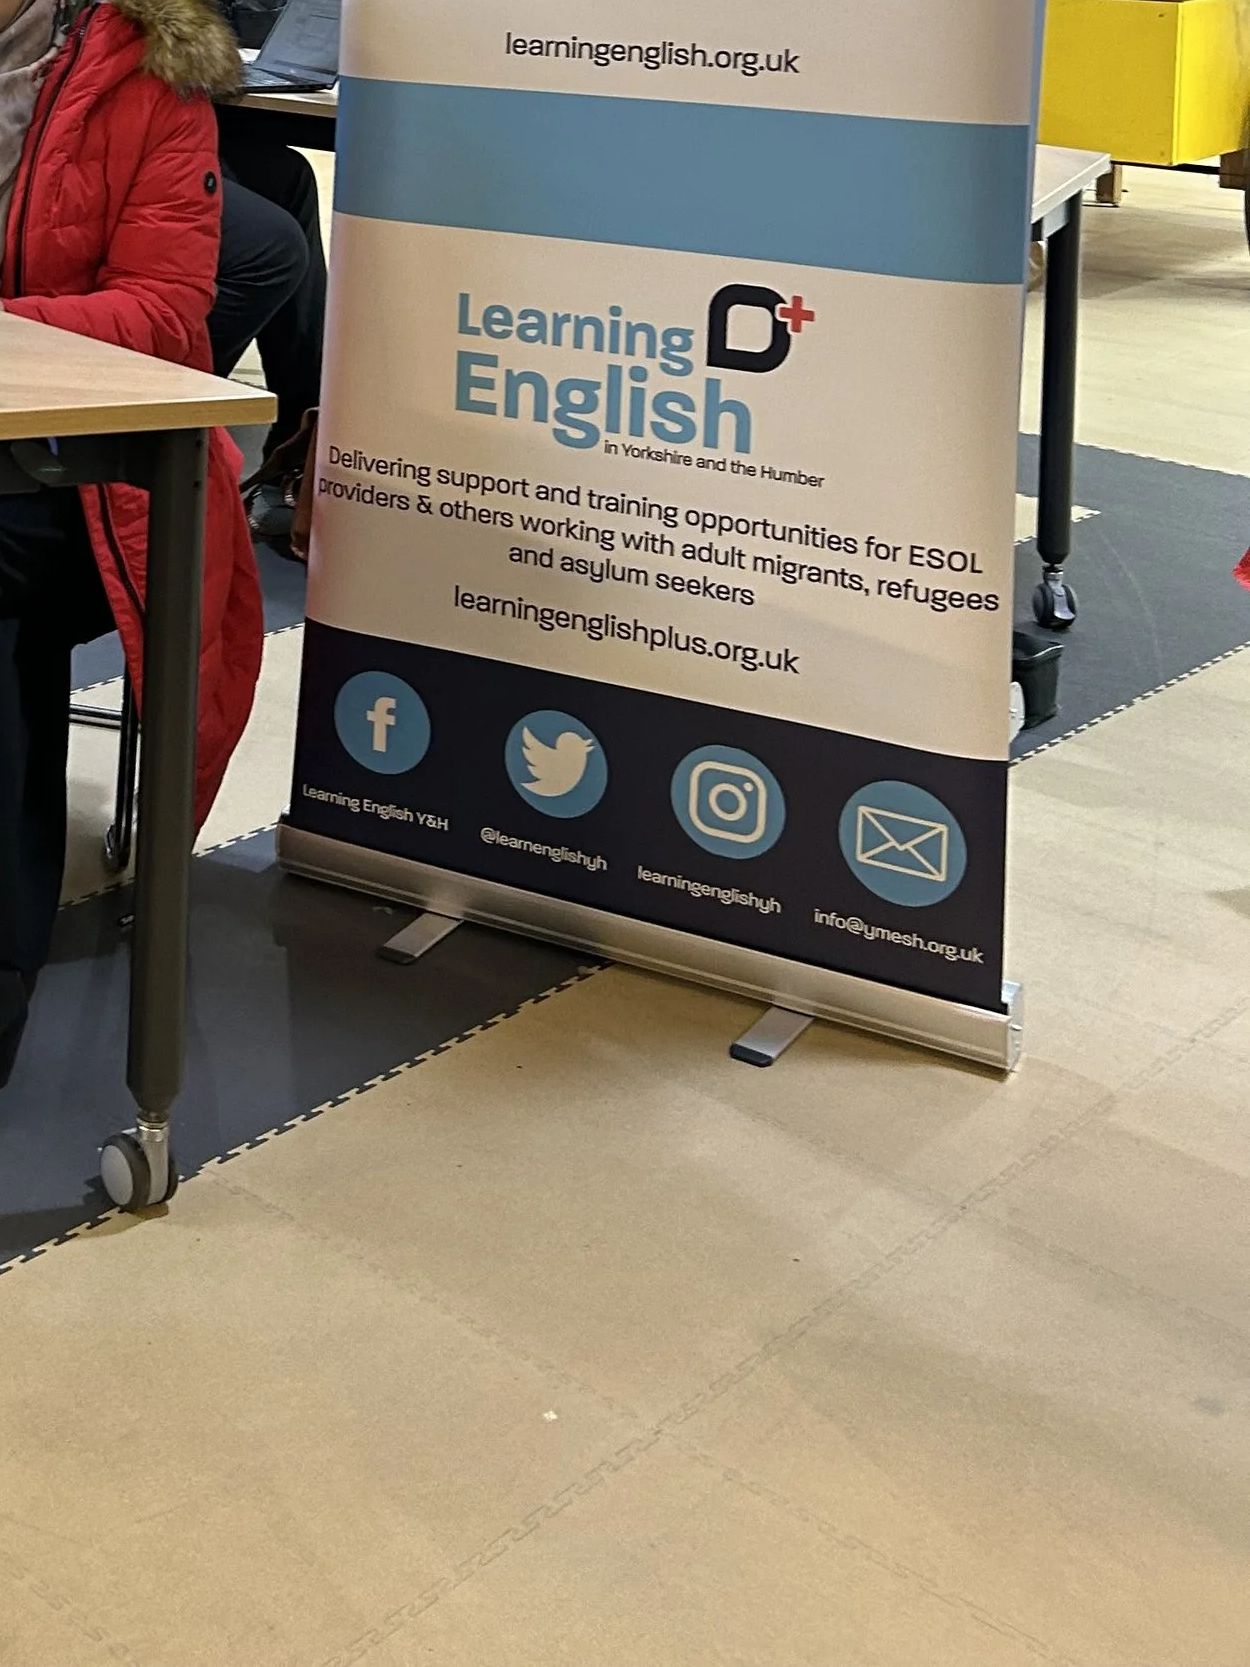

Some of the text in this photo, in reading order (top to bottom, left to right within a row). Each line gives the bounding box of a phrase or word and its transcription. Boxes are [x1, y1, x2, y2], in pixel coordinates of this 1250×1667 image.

[506, 32, 799, 76] learningenglish.org.uk
[458, 291, 694, 377] Learning
[454, 350, 752, 454] English
[605, 440, 825, 487] in Yorkshire and the Humber
[329, 445, 983, 573] Delivering support and training opportunities for ESOL
[319, 478, 999, 612] providers & others working with adult migrants, refugees
[509, 541, 755, 607] and asylum seekers
[454, 584, 800, 675] learningenglishplus.org.uk
[303, 784, 448, 830] Learning English Y&H
[481, 828, 607, 871] @learnenglishyh
[638, 866, 781, 913] learningenglishyh
[815, 909, 983, 963] info@ymesh.org.uk
